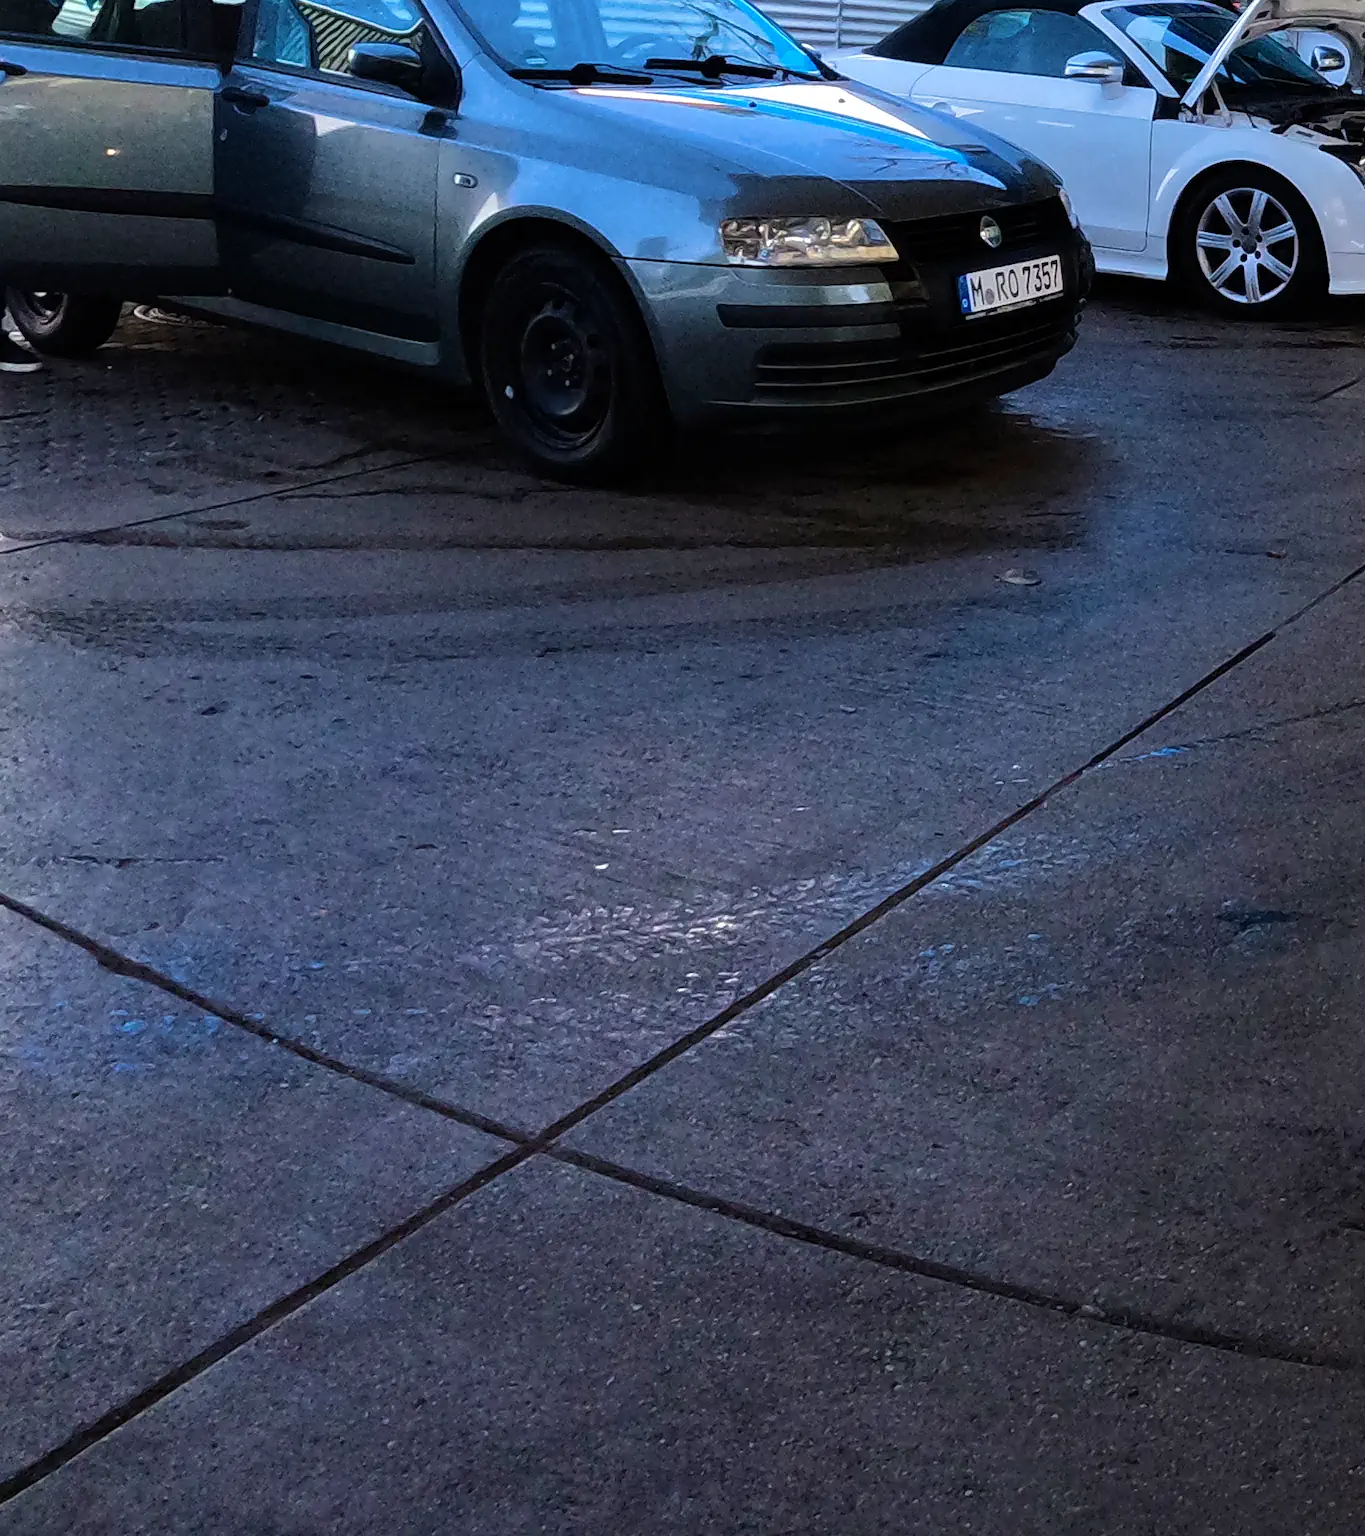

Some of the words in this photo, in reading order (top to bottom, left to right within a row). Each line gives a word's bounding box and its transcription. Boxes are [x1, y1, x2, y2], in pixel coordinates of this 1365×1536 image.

[970, 276, 985, 307] M
[995, 269, 1019, 301] RO
[1022, 260, 1059, 295] 7357
